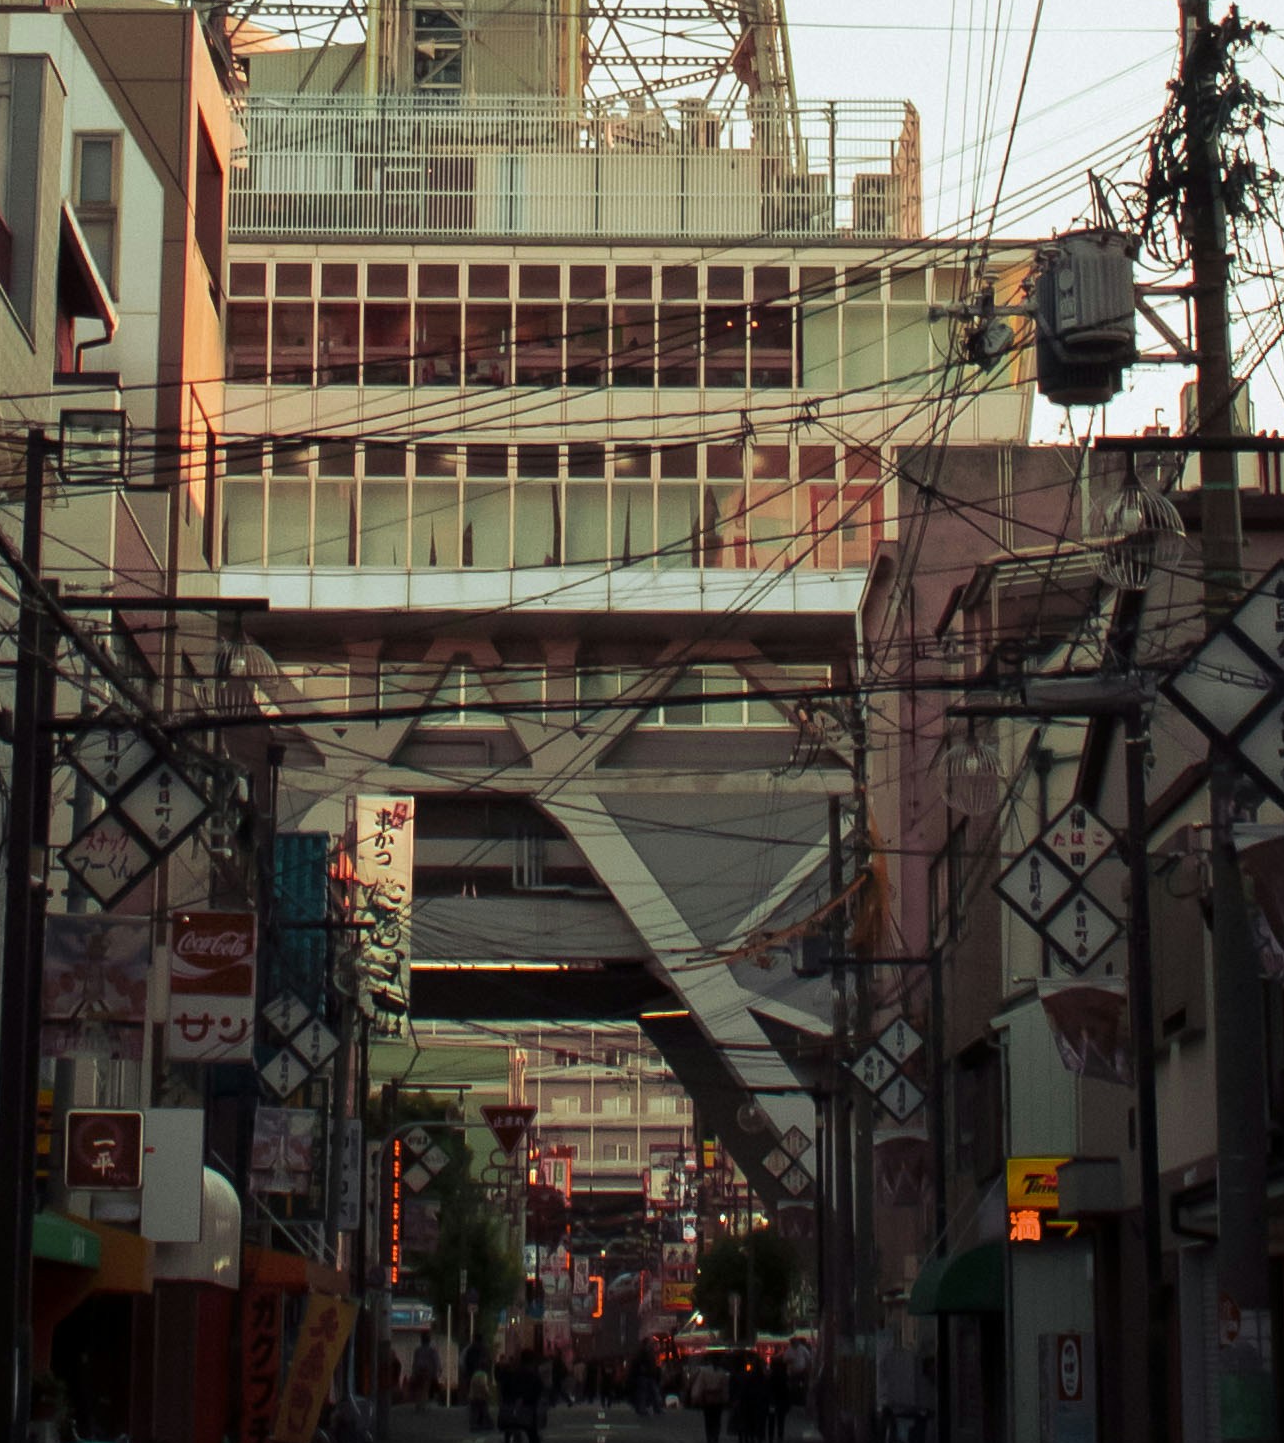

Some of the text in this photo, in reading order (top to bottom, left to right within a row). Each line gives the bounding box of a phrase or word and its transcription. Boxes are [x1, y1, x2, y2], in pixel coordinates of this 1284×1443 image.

[155, 771, 173, 840] 春日町会
[373, 807, 395, 866] 串かつ
[1028, 855, 1043, 912] 春日町会
[1074, 898, 1089, 958] 春日町会
[493, 1114, 526, 1127] 止まれ
